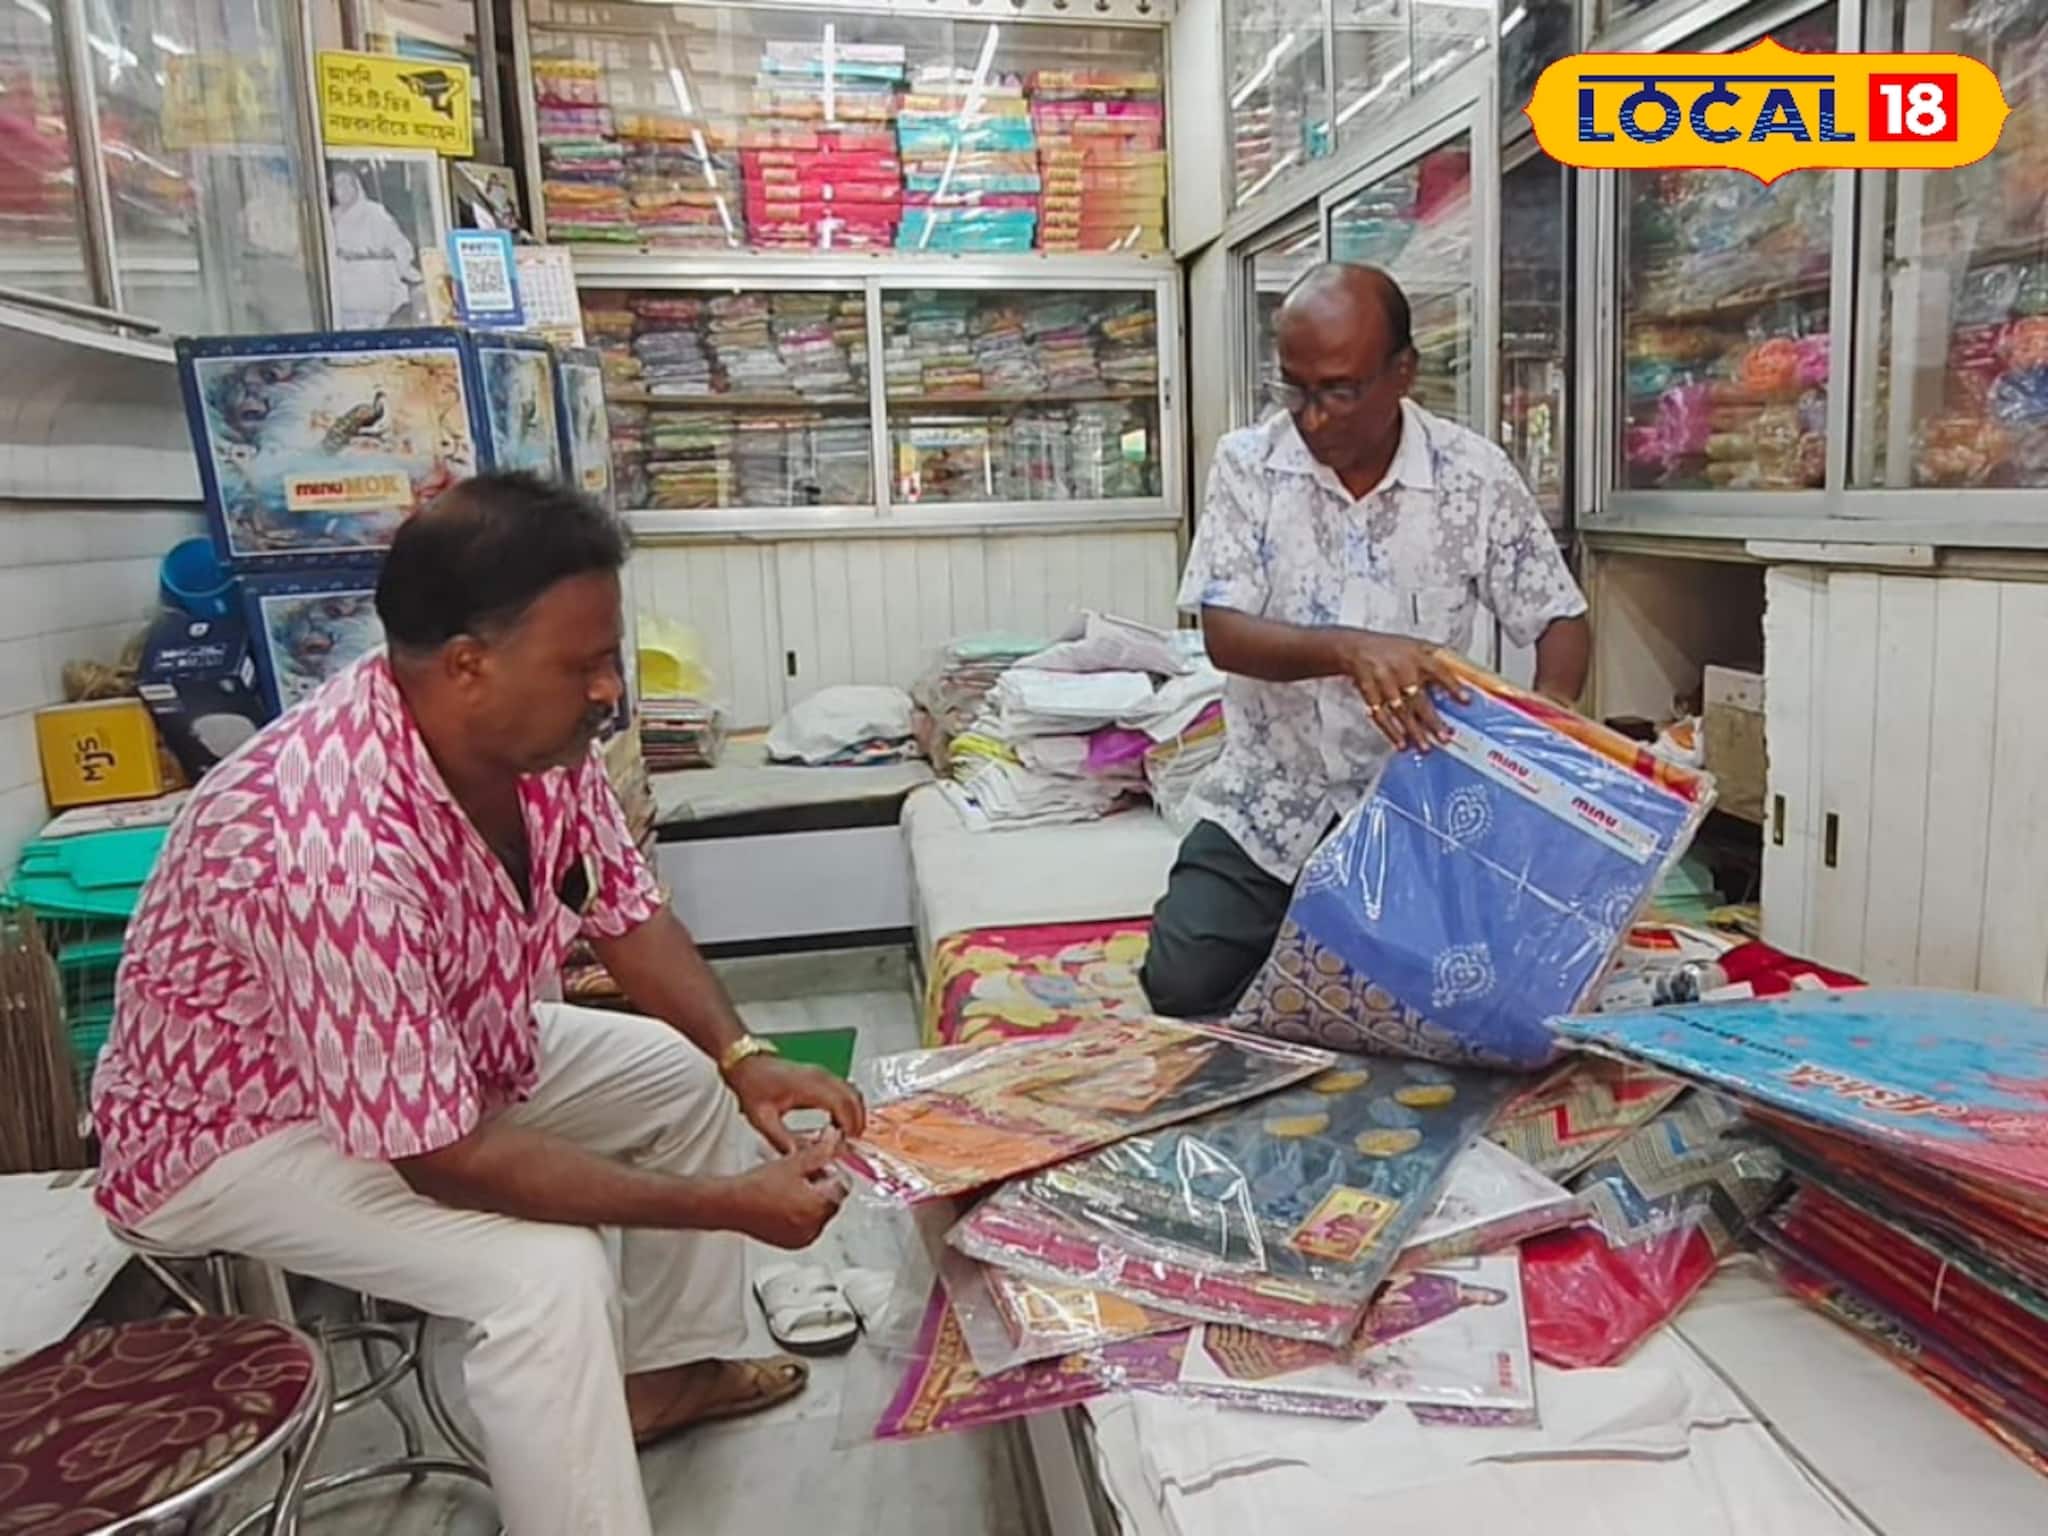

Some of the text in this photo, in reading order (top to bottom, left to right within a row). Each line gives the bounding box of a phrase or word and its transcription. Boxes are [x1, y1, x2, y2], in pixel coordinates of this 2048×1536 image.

[327, 64, 371, 83] আপনি
[1487, 748, 1530, 777] minu
[1571, 796, 1618, 828] minu
